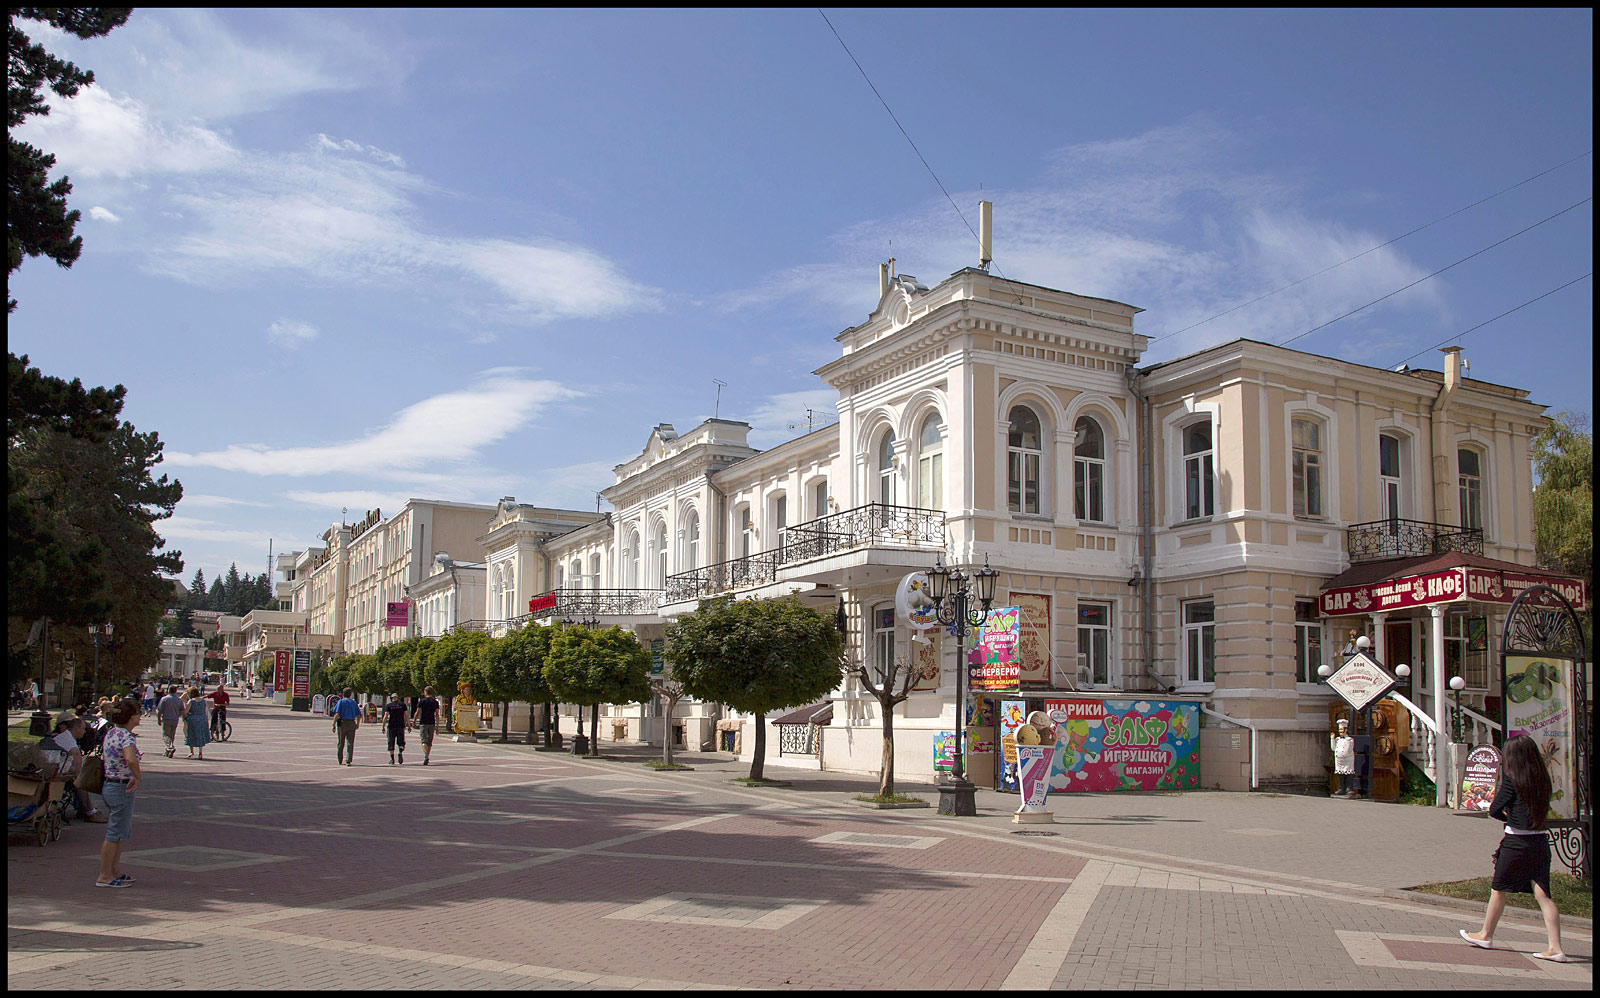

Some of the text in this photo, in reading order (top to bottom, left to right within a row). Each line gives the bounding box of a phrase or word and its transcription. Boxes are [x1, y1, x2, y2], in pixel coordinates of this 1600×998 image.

[1372, 581, 1411, 597] ПРАСКОВЙСКИЙ
[1428, 574, 1462, 597] КАФЕ
[1469, 575, 1491, 595] БАР
[1325, 592, 1351, 611] БАР
[985, 614, 1015, 633] ЭЛЬФ
[985, 634, 1015, 642] ИГРУШКИ
[970, 666, 1019, 677] ФЕЙЕРВЕРКИ
[1103, 716, 1168, 746] ЭЛЬФ
[1104, 750, 1168, 763] ИГРУШКИ
[1125, 766, 1163, 775] МАГАЗИН
